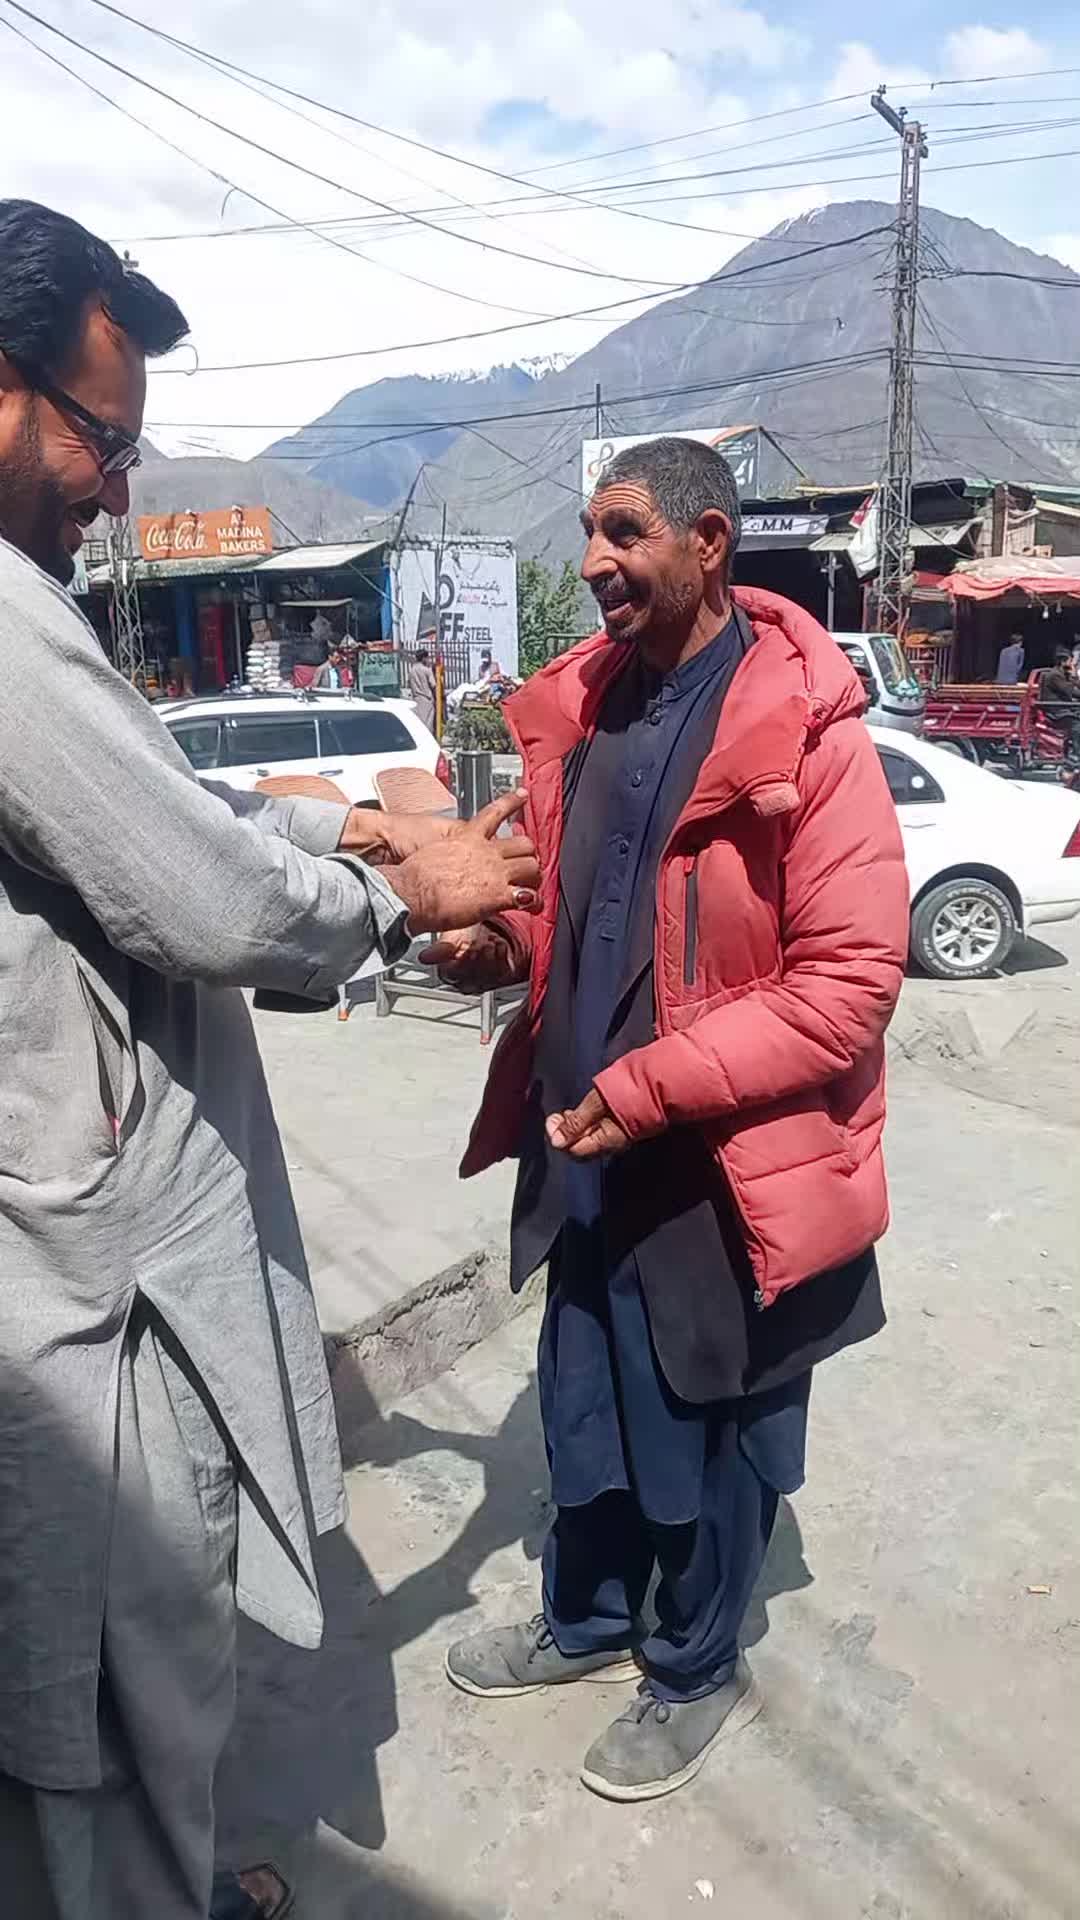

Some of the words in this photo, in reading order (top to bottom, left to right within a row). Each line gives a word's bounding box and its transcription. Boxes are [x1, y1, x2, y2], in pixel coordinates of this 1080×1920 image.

[217, 526, 263, 540] MADINA
[220, 539, 266, 553] BAKERS
[464, 627, 493, 641] STEEL
